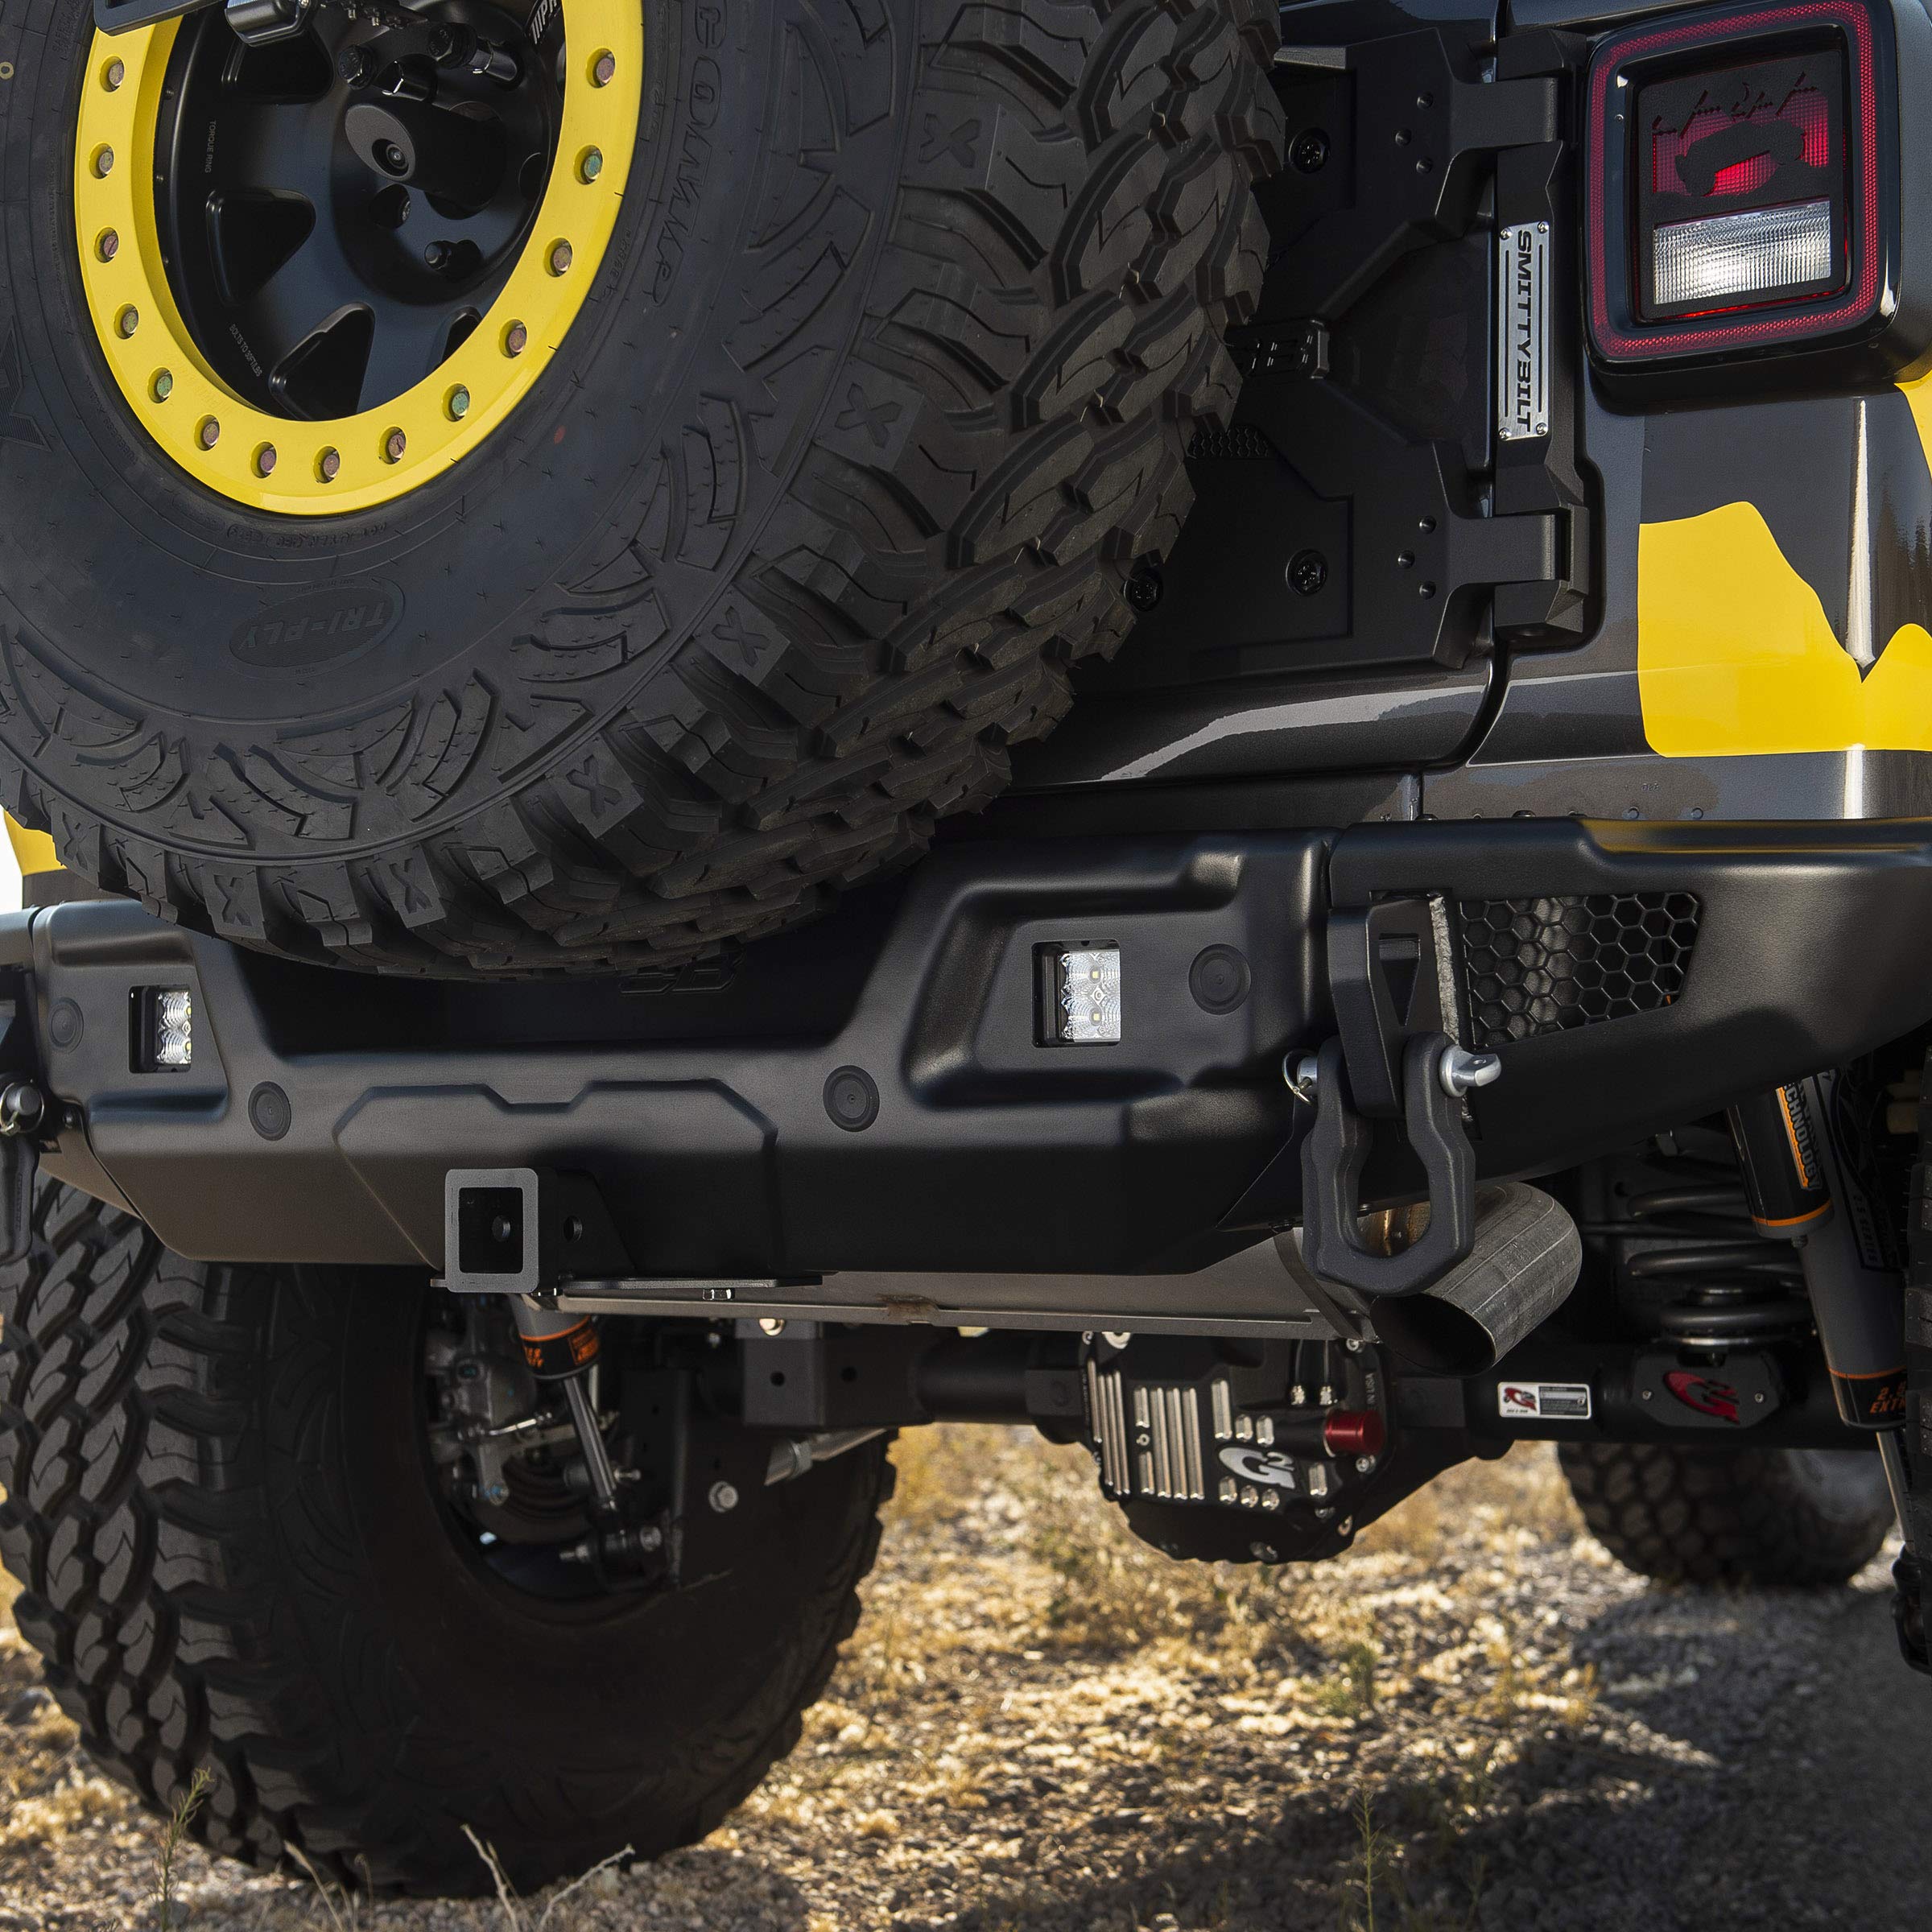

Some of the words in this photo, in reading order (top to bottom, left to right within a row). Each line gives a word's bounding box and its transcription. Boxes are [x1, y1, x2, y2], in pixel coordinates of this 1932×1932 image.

[207, 119, 217, 153] TORQUE
[204, 154, 213, 173] RING
[229, 324, 244, 345] BOLTS
[240, 341, 249, 353] TO
[1517, 229, 1532, 432] SMITTYBILT
[237, 601, 386, 650] TRI-PLY
[1783, 1083, 1821, 1188] CHNOLOGY
[1217, 1445, 1297, 1491] G2
